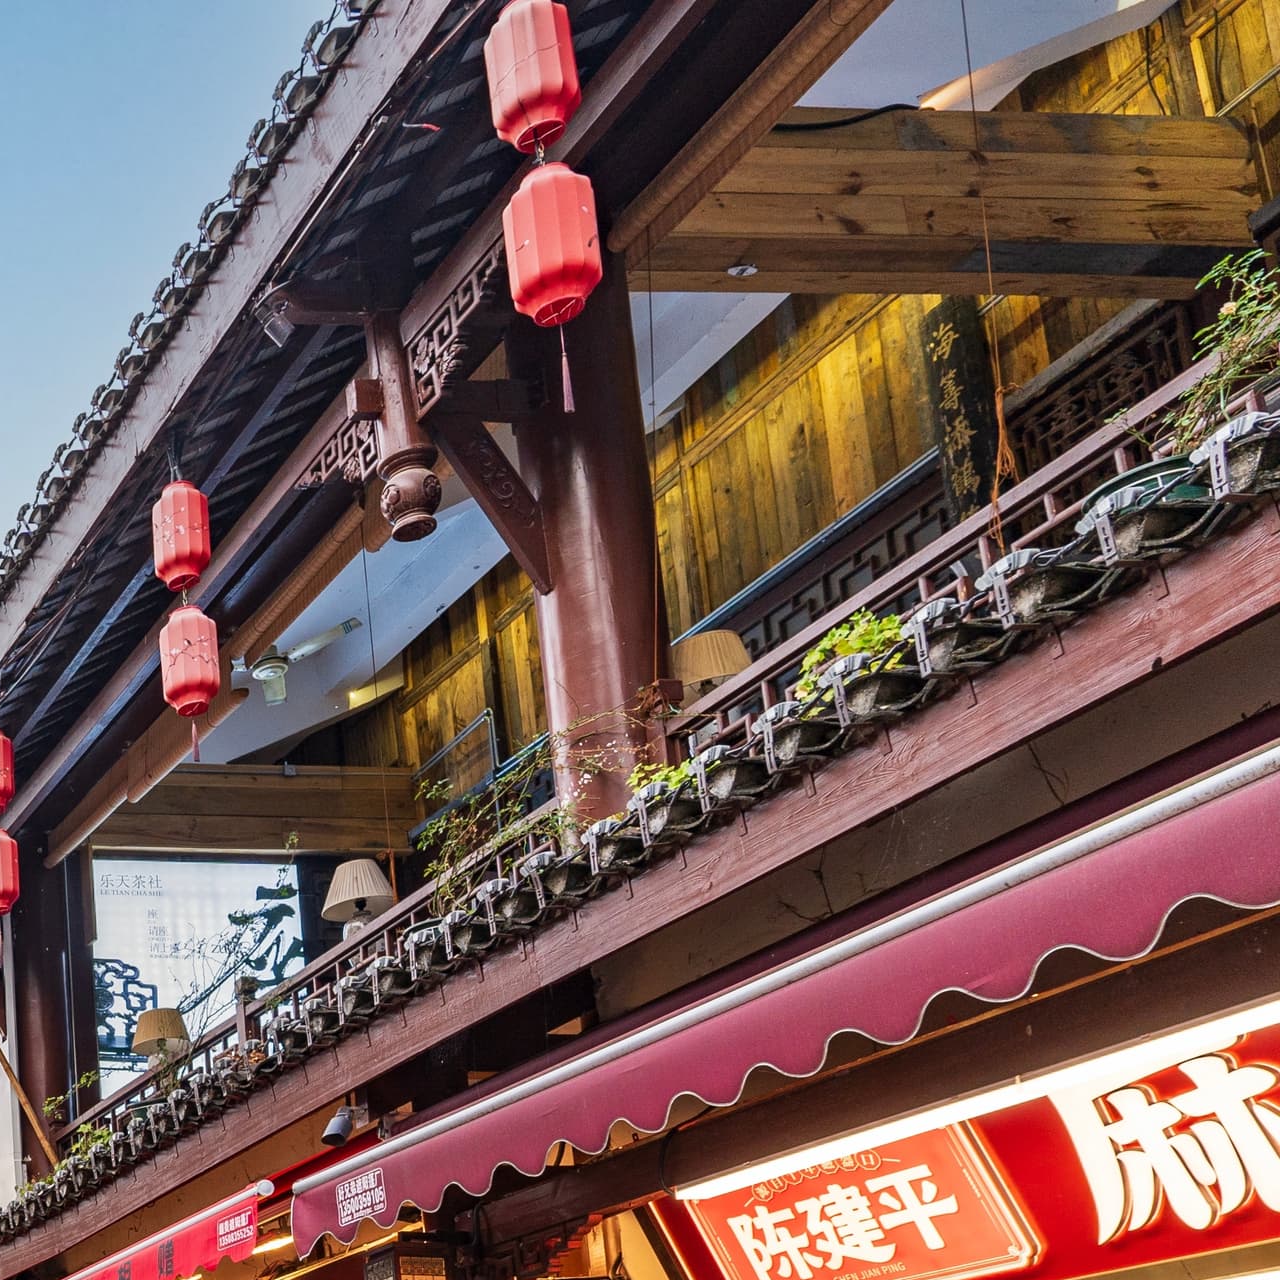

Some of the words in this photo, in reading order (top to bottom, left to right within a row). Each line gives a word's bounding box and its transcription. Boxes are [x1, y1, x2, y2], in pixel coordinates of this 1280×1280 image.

[927, 322, 982, 523] 海籌添鶴
[99, 873, 164, 890] 乐天茶社
[859, 1263, 881, 1280] JIAN
[881, 1261, 906, 1277] PING
